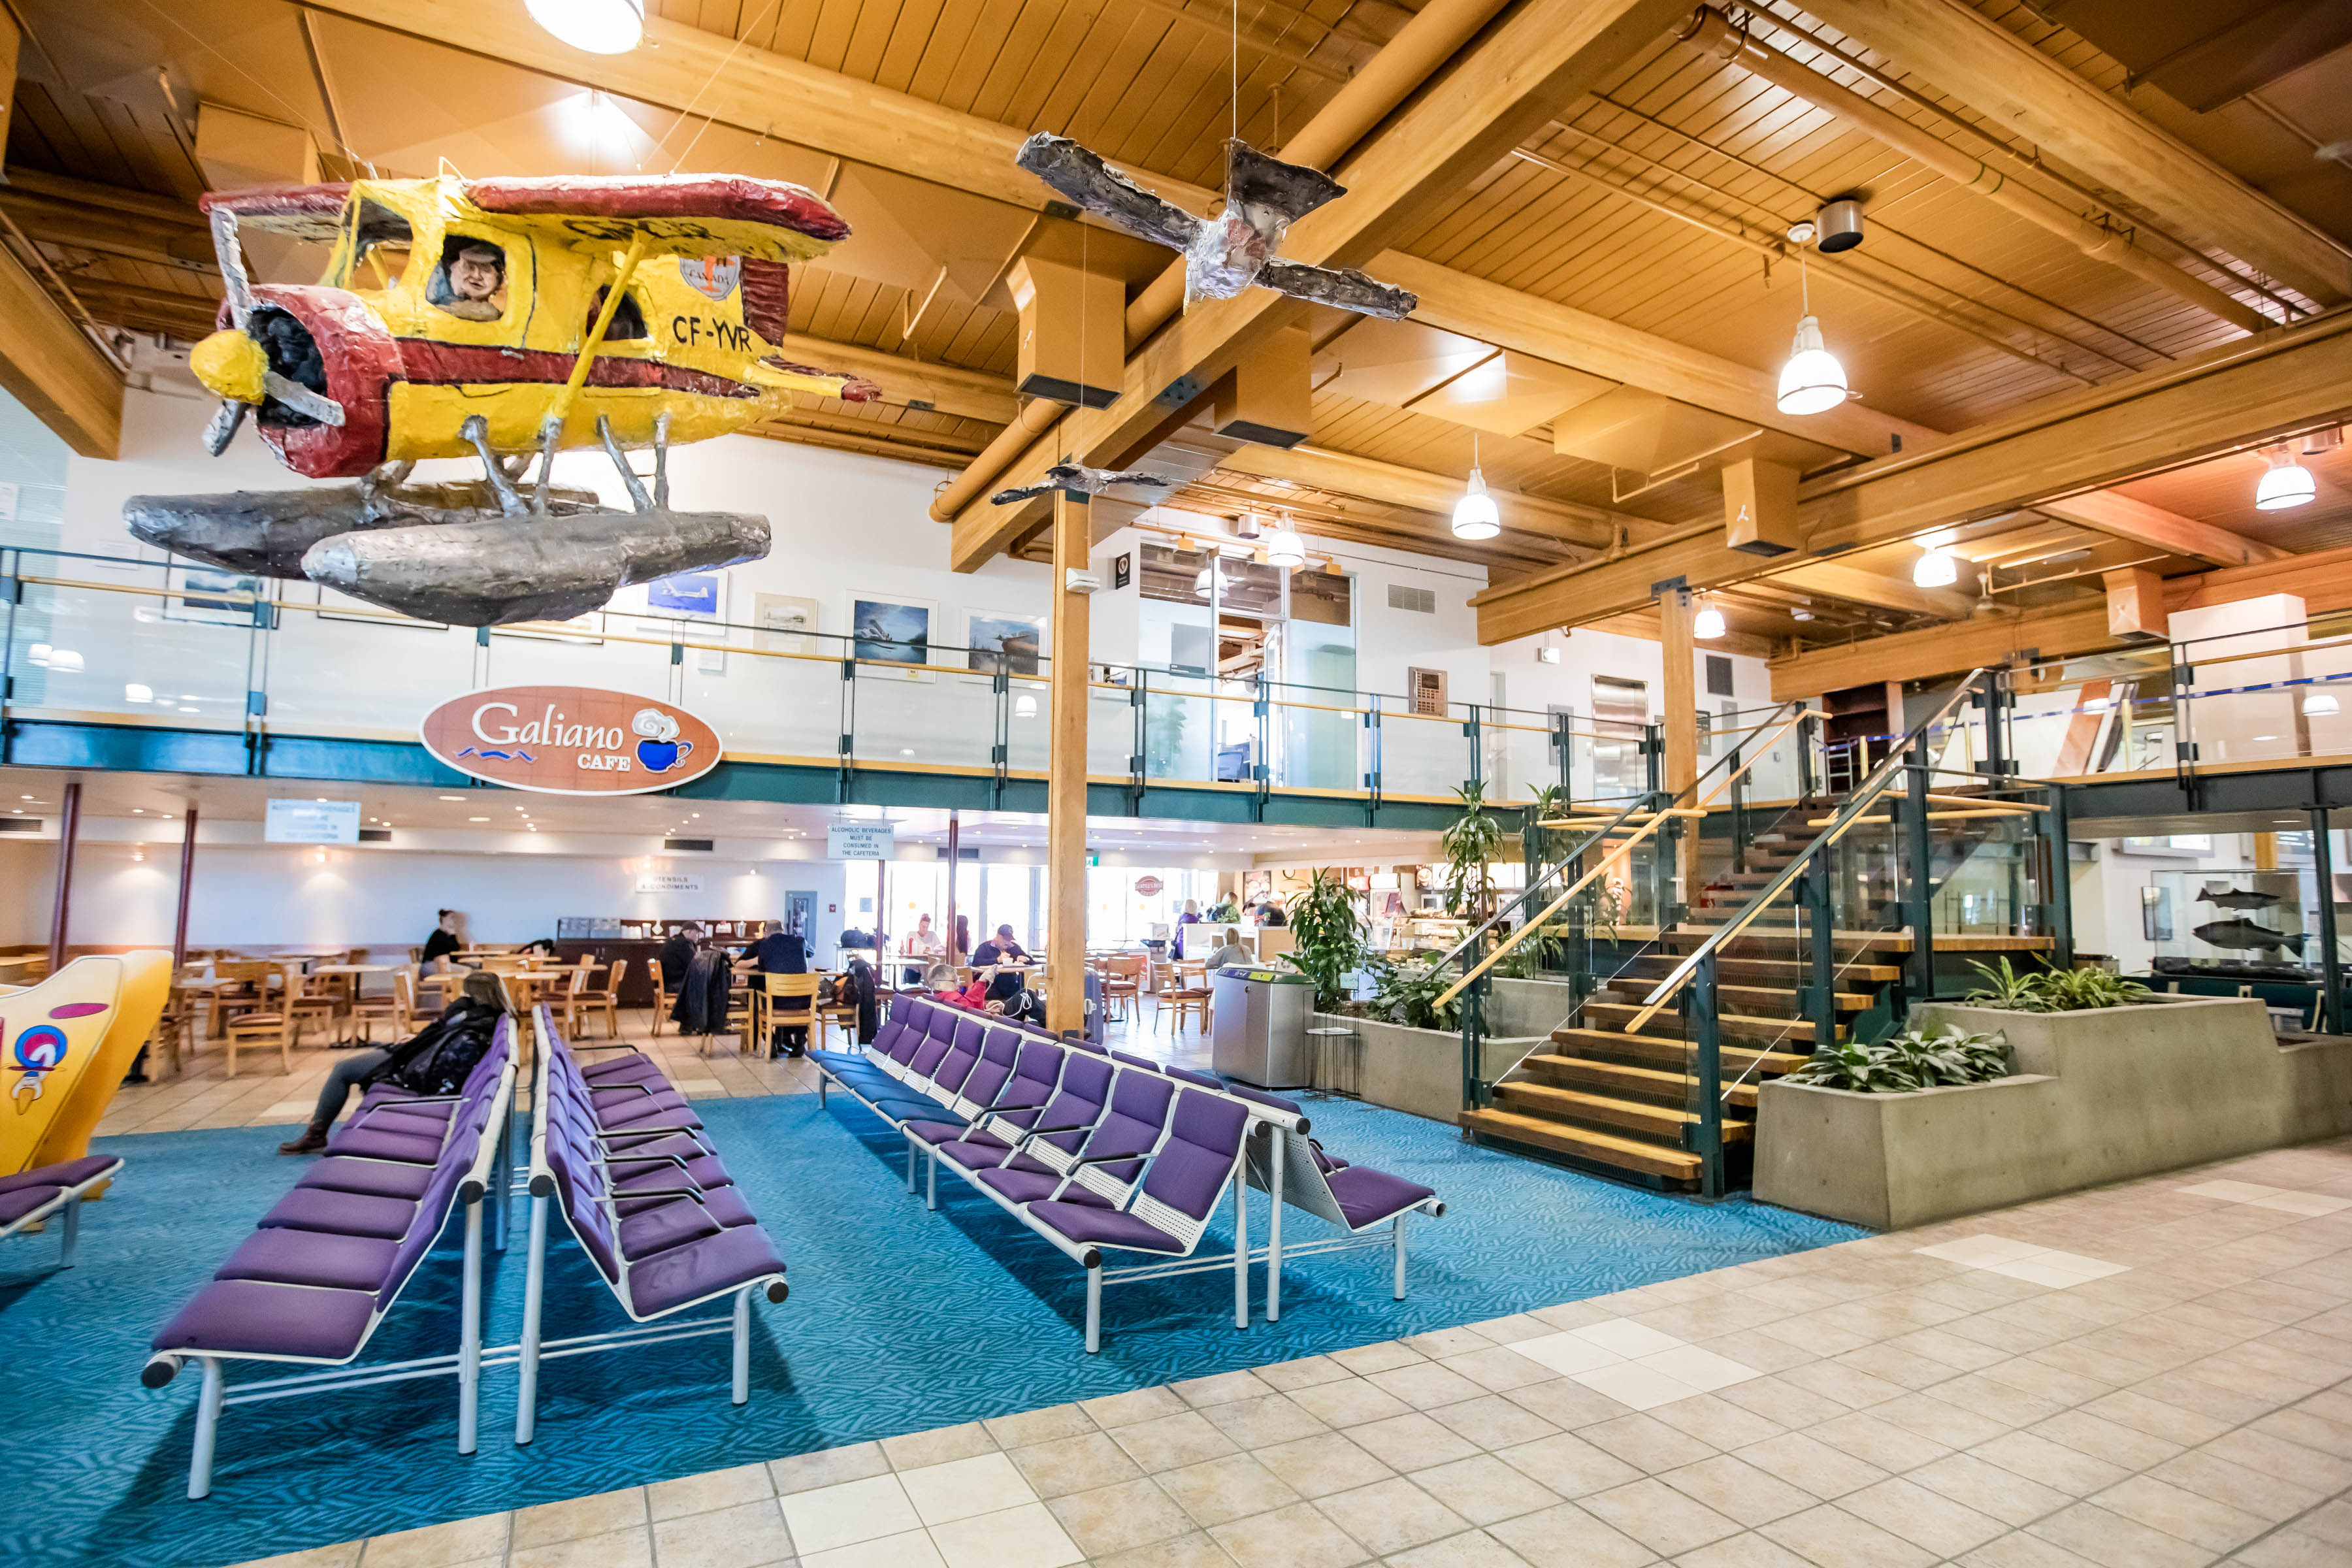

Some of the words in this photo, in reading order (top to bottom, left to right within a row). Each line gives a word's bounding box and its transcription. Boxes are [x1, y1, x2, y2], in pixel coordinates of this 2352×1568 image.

[689, 269, 730, 286] CANADA
[673, 316, 752, 351] CF-YVR
[472, 702, 623, 750] Galiano
[578, 754, 631, 772] CAFE
